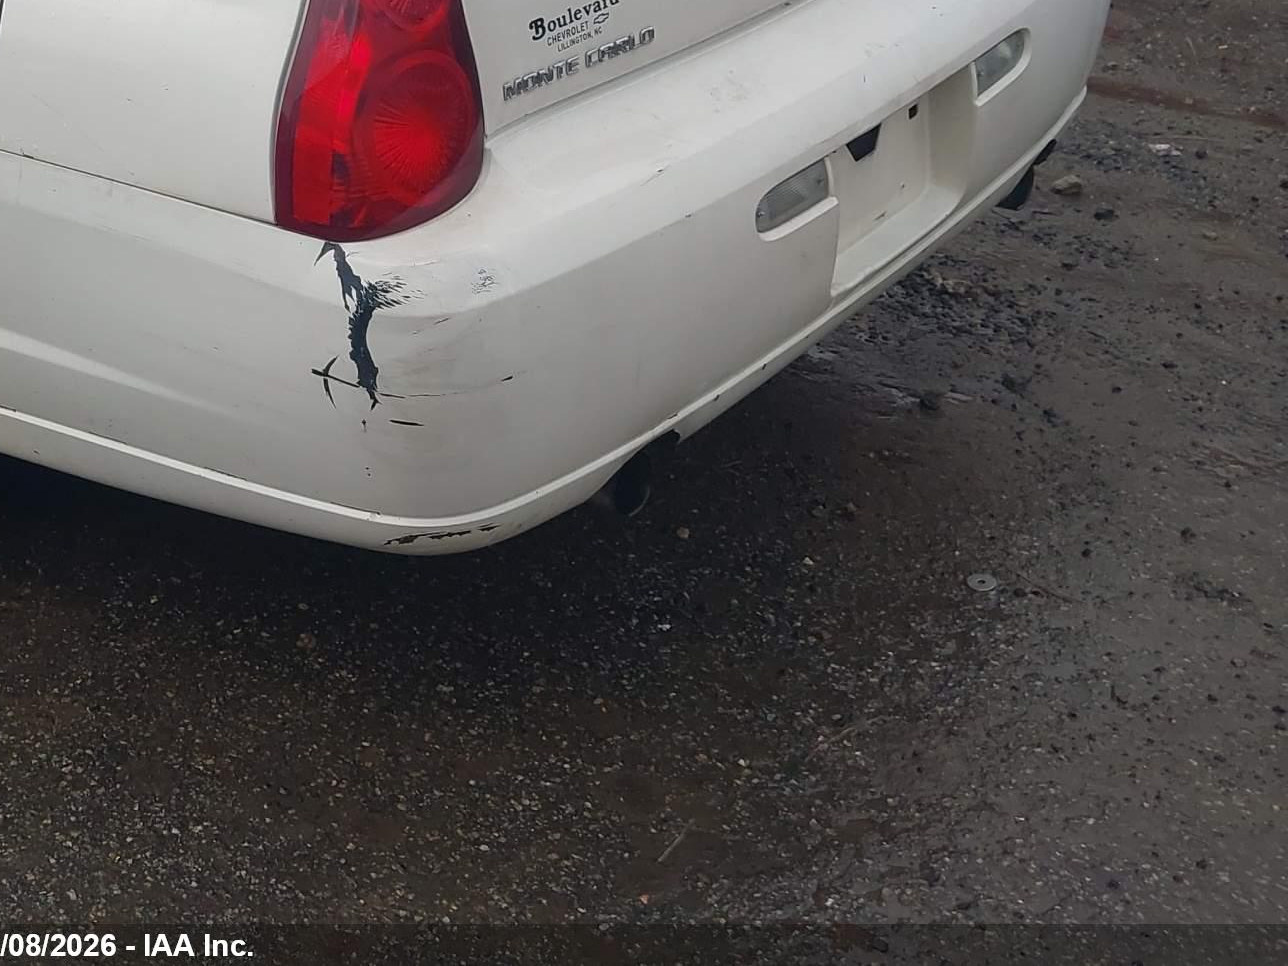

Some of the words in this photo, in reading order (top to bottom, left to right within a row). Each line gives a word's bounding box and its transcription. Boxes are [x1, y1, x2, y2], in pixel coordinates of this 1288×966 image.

[547, 20, 590, 46] CHEVROLET
[594, 26, 603, 38] NC
[502, 55, 580, 101] MONTE
[584, 26, 655, 68] CARLO
